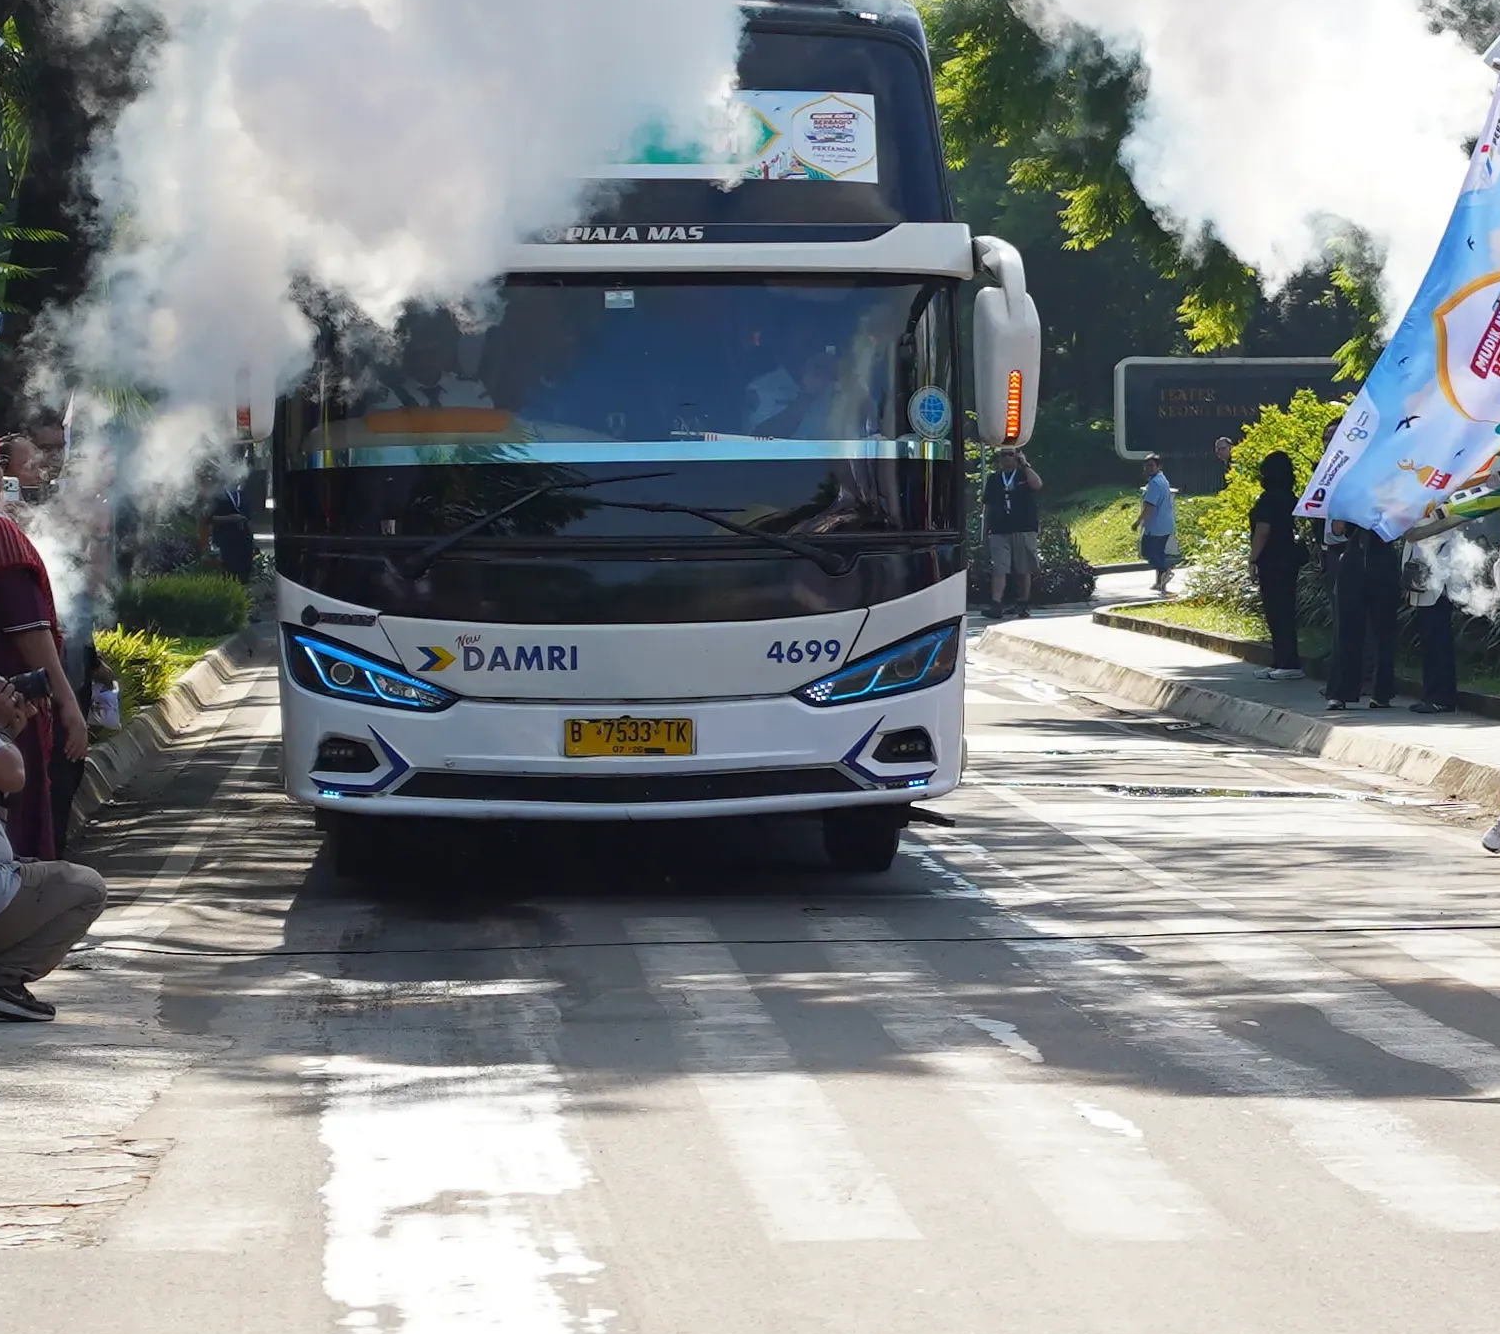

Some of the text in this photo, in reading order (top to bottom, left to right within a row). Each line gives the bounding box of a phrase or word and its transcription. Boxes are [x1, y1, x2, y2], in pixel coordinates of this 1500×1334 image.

[566, 226, 704, 241] PIALA MAS
[455, 634, 482, 651] New
[766, 639, 841, 664] 4699
[464, 646, 578, 672] DAMRI
[571, 721, 687, 743] B 7533 TK
